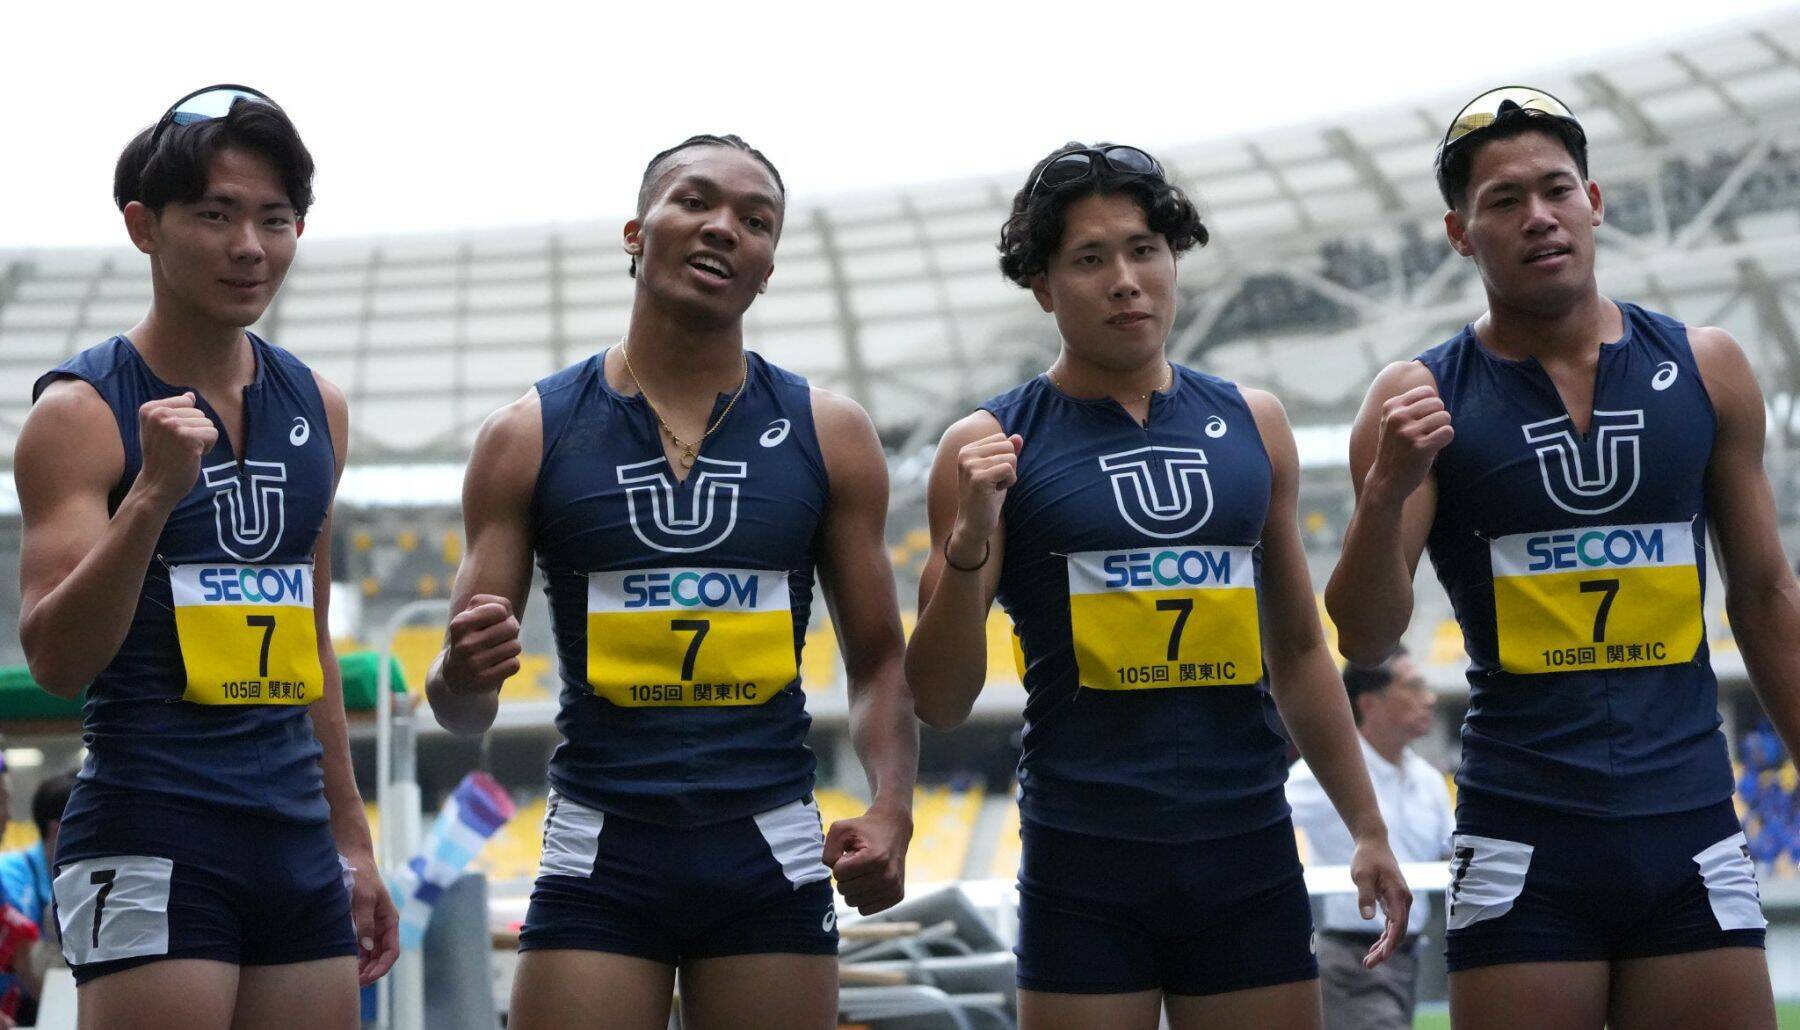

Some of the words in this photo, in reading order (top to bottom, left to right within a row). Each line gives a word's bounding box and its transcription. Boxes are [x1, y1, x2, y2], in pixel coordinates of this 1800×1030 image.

[1104, 550, 1230, 588] SECOM
[1526, 529, 1664, 571] SECOM
[200, 568, 304, 603] SECOM
[623, 572, 759, 608] SECOM
[1156, 598, 1193, 661] 7
[1579, 579, 1620, 643] 7
[246, 615, 276, 677] 7
[671, 619, 710, 681] 7
[1542, 647, 1596, 667] 105回
[1606, 641, 1666, 663] 関東IC
[222, 681, 261, 699] 105回
[268, 681, 305, 700] 関東IC
[630, 685, 683, 701] 105回
[693, 682, 757, 701] 関東IC
[1117, 665, 1169, 684] 105回
[1179, 662, 1236, 682] 関東IC
[90, 869, 116, 949] 7
